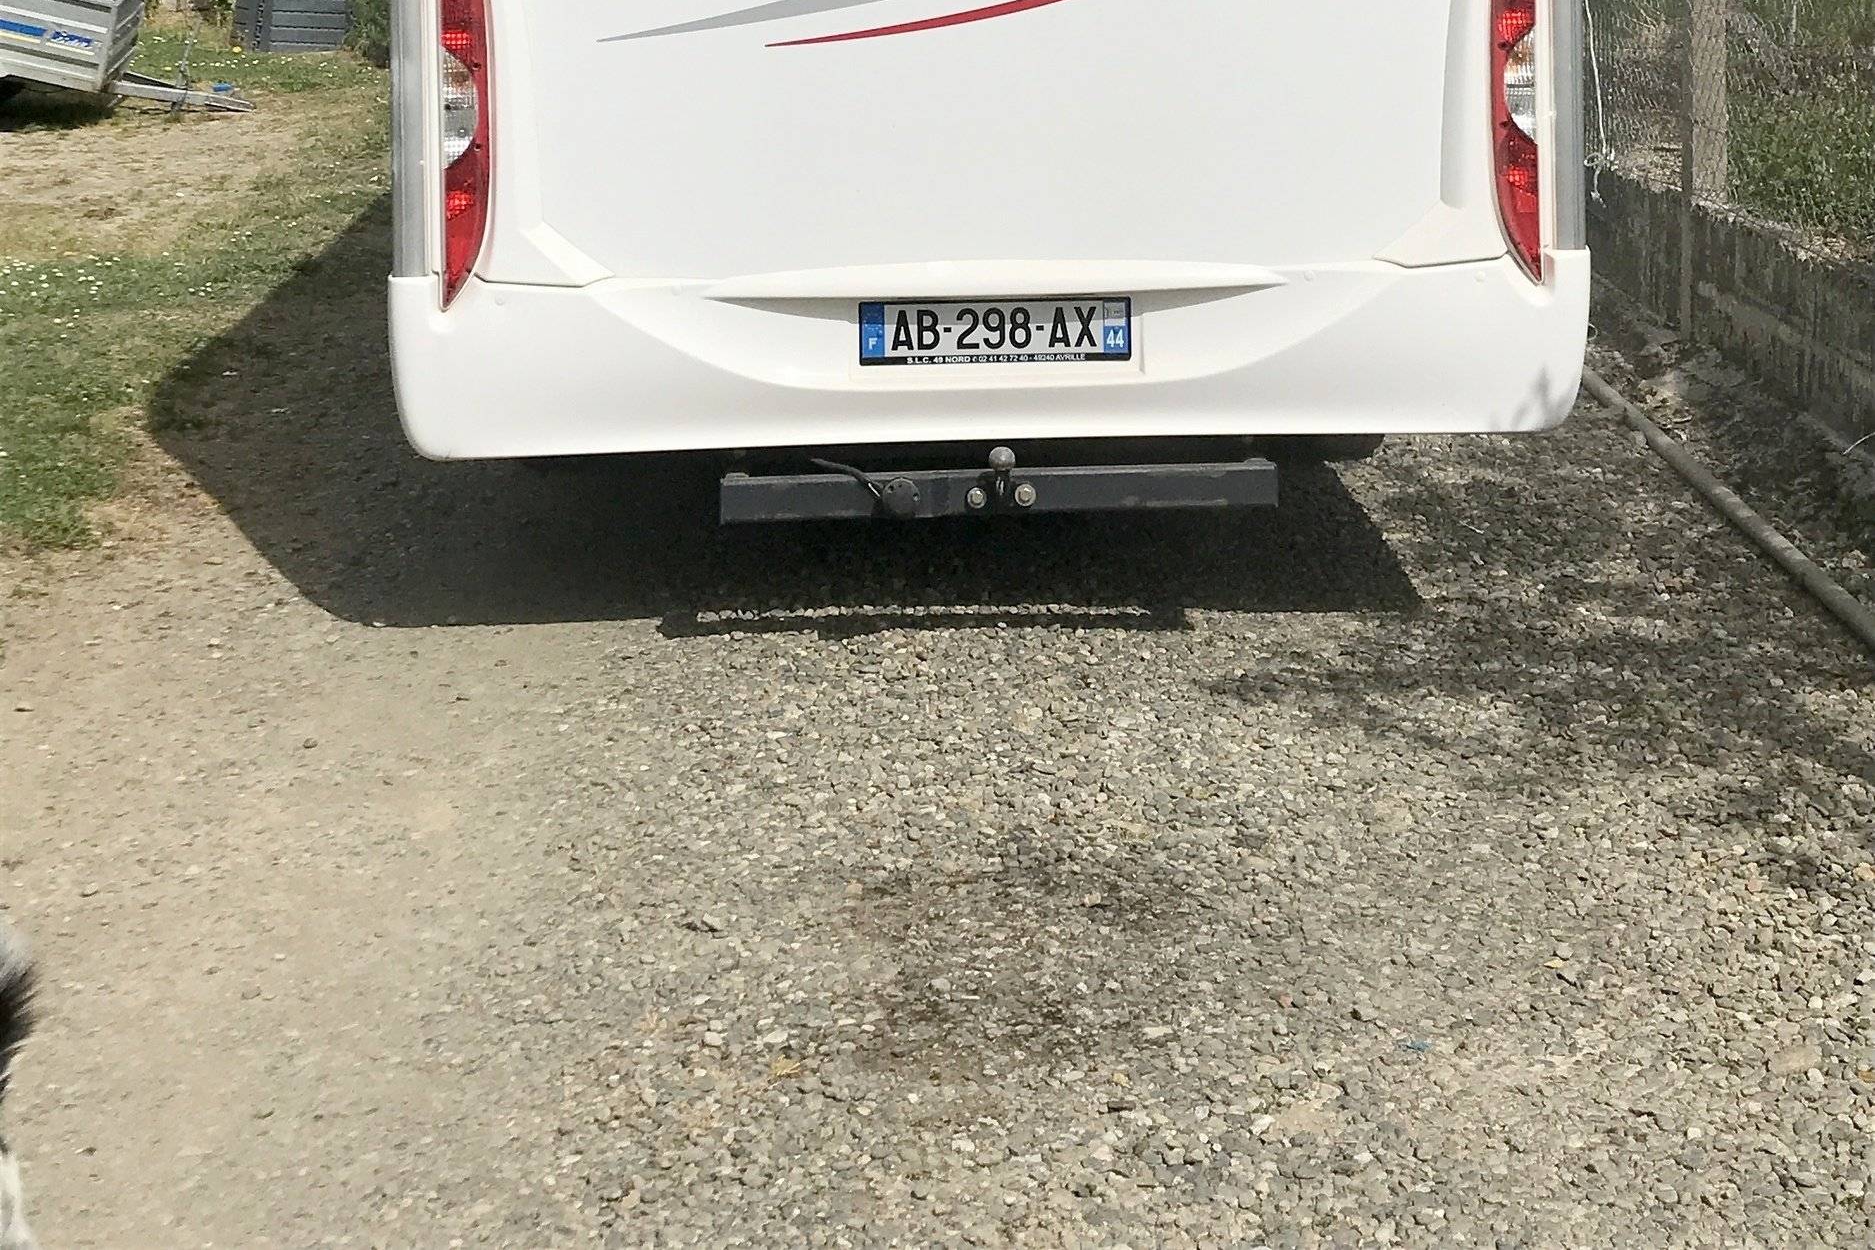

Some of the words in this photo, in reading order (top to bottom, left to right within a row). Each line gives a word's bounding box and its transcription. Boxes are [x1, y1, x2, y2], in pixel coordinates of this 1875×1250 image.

[891, 306, 1098, 351] AB-298-AX
[868, 337, 878, 349] F
[1106, 328, 1125, 348] 44
[945, 355, 971, 363] NORD
[978, 355, 988, 363] 02
